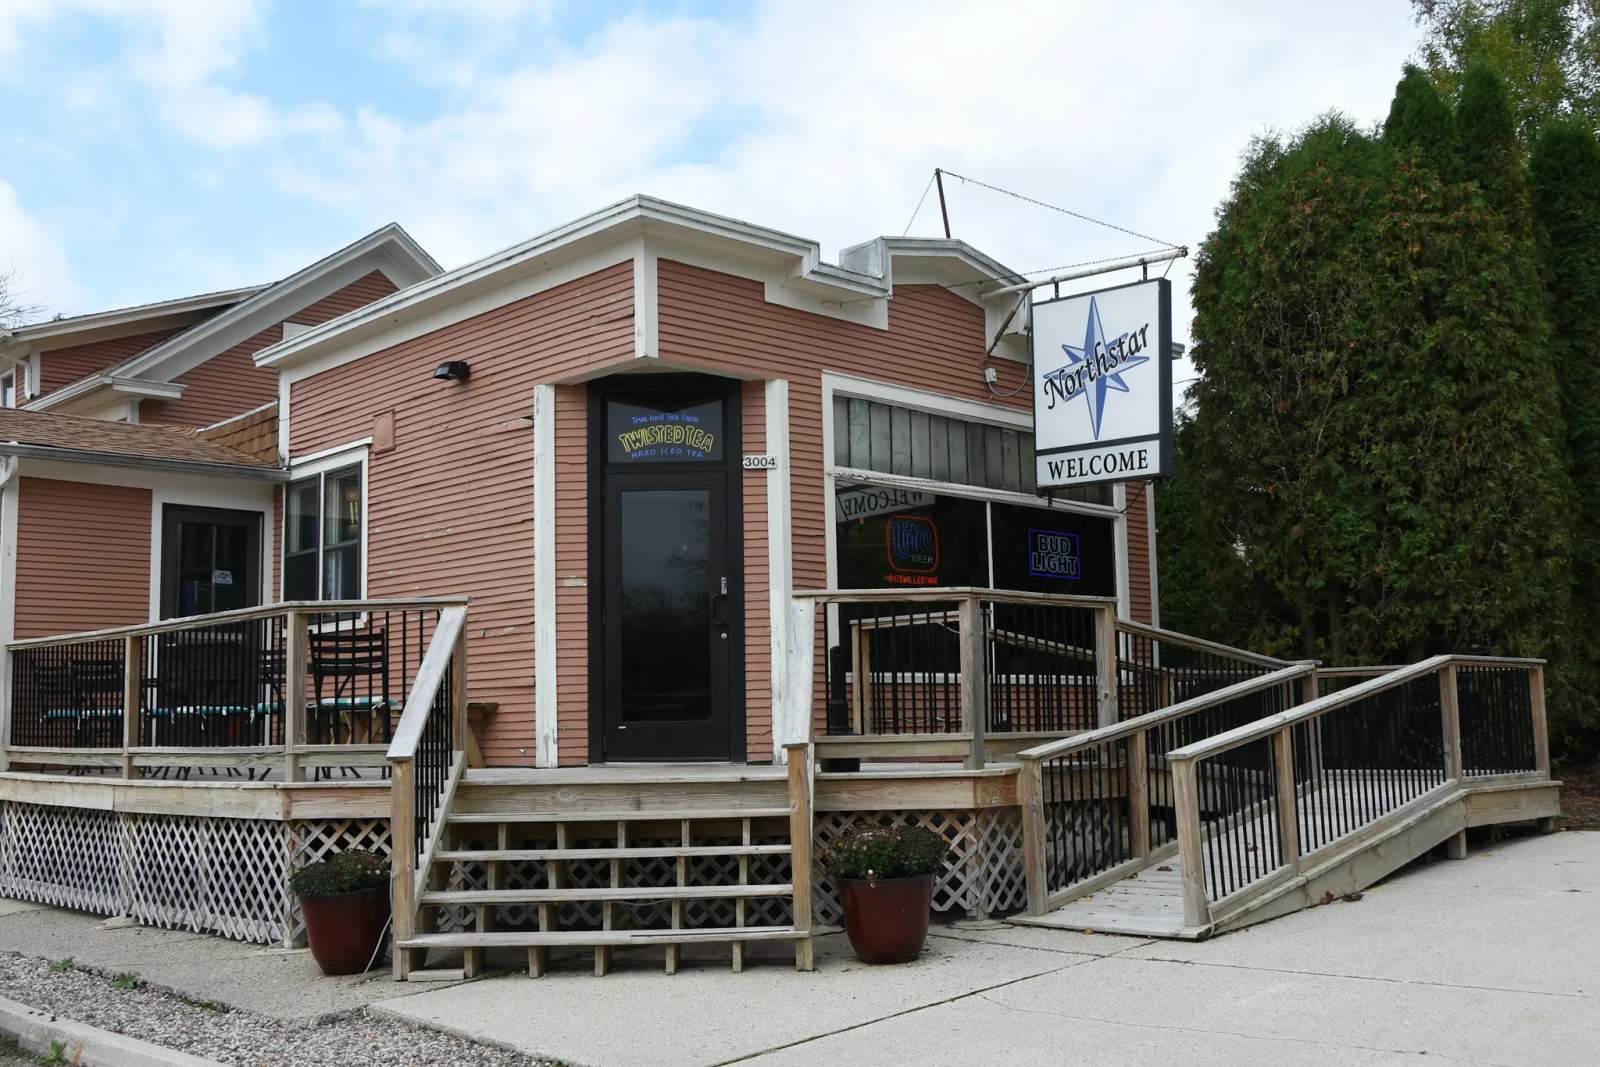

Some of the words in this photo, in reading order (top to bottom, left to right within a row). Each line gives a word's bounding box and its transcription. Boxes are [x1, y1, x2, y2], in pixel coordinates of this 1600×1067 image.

[1043, 322, 1149, 410] Northstar
[619, 425, 685, 452] TWISTED
[685, 425, 715, 453] TEA
[631, 449, 656, 459] HARD
[660, 447, 682, 456] ICED
[687, 449, 704, 458] TEA
[744, 457, 776, 468] 3004
[1048, 449, 1149, 480] WELCOME
[1037, 534, 1071, 555] BUD
[1032, 552, 1077, 575] LIGHT
